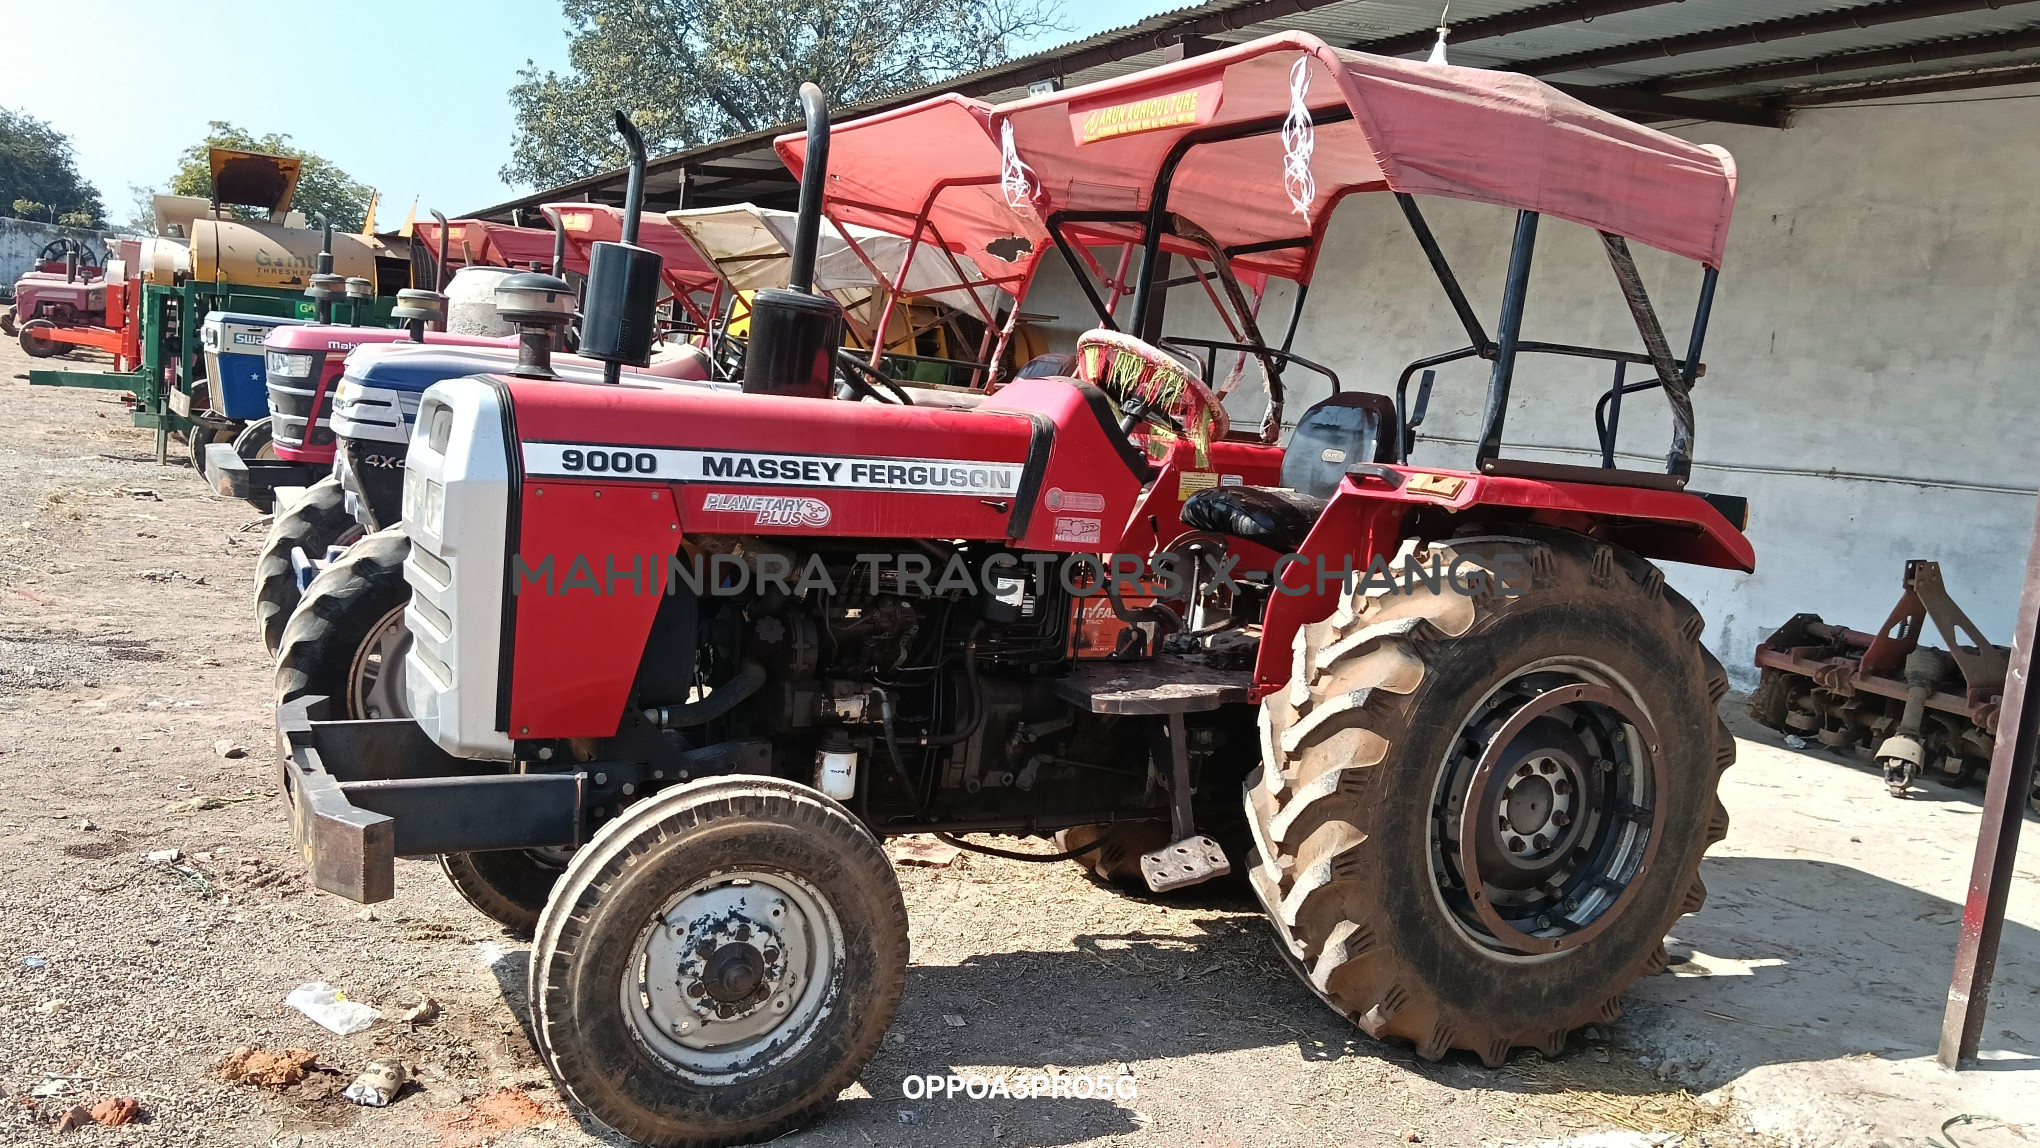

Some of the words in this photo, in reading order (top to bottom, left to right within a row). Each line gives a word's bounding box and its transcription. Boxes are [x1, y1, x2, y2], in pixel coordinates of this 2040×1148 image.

[1100, 104, 1126, 126] ARUN
[1126, 91, 1198, 121] AGRICULTURE
[562, 449, 658, 474] 9000
[702, 456, 842, 484] MASSEY
[851, 463, 1011, 490] FERGUSON
[705, 493, 807, 512] PLANETARY
[756, 510, 802, 525] PLUS
